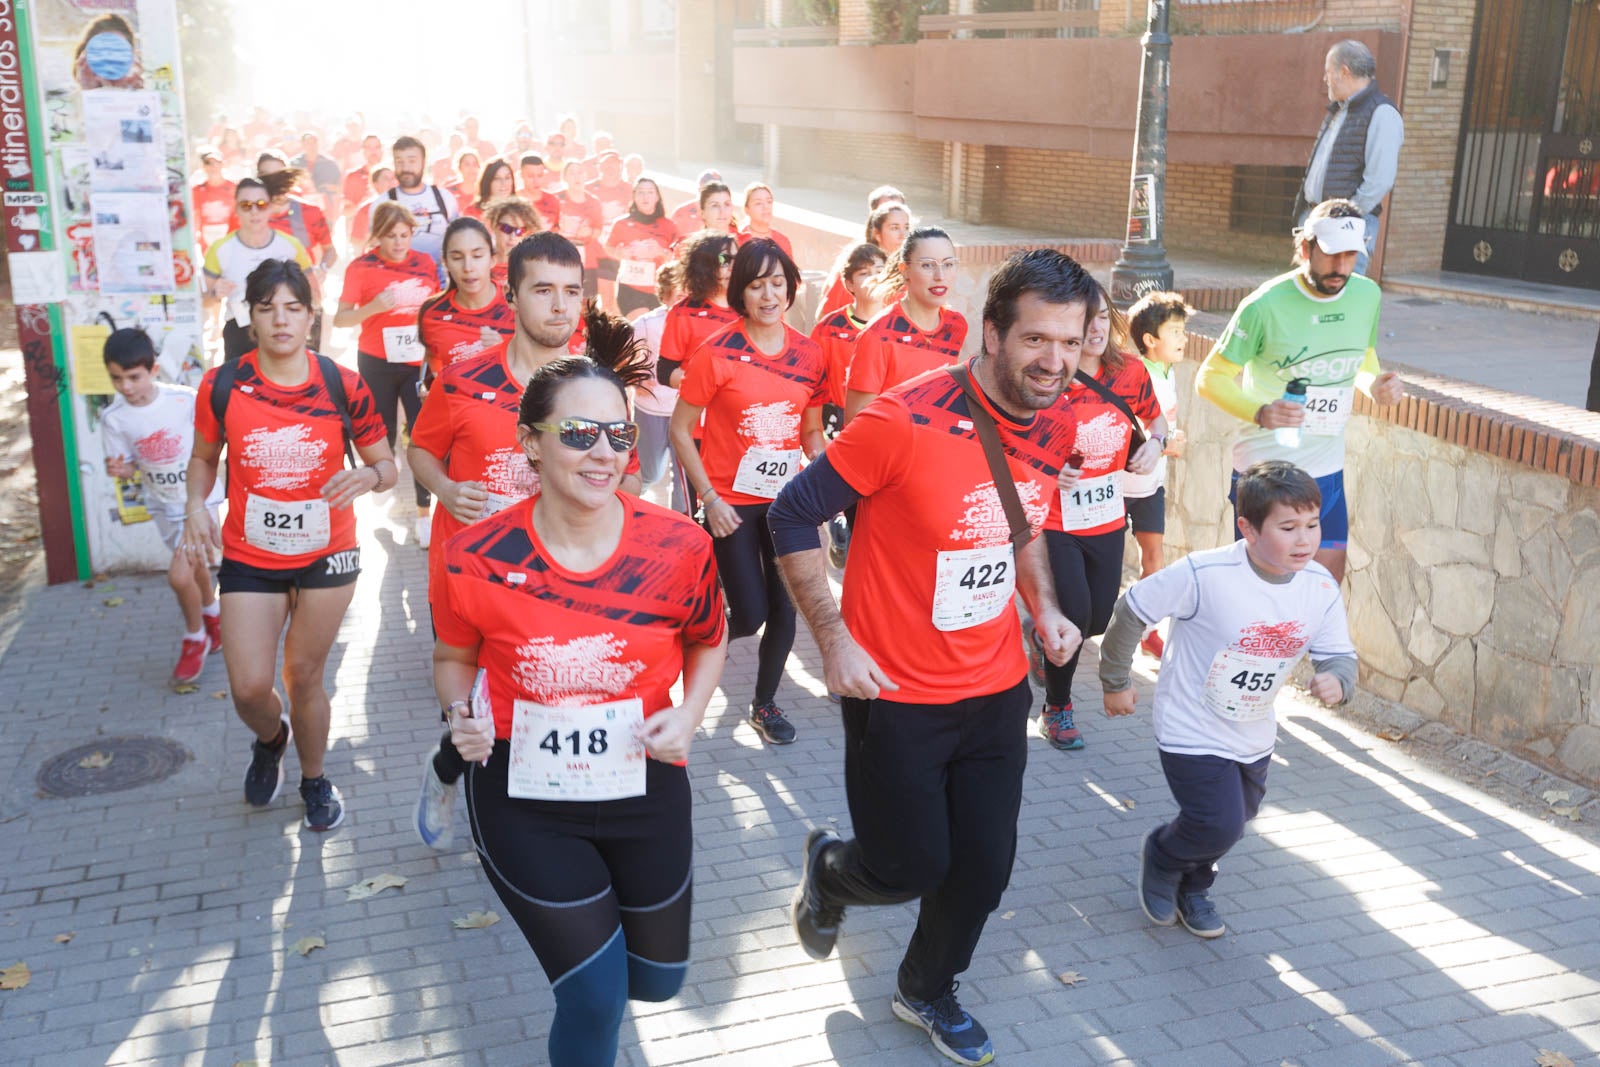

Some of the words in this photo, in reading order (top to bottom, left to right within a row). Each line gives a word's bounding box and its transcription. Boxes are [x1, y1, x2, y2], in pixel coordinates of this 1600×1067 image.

[1306, 399, 1338, 413] 426
[744, 416, 797, 427] carrera
[246, 443, 320, 457] carrera
[756, 461, 787, 476] 420
[147, 470, 187, 485] 1500
[1072, 484, 1114, 506] 1138
[264, 512, 303, 530] 821
[960, 561, 1007, 590] 422
[1240, 636, 1304, 648] carrera
[519, 660, 632, 682] carrera
[1231, 670, 1276, 692] 455
[539, 728, 608, 756] 418
